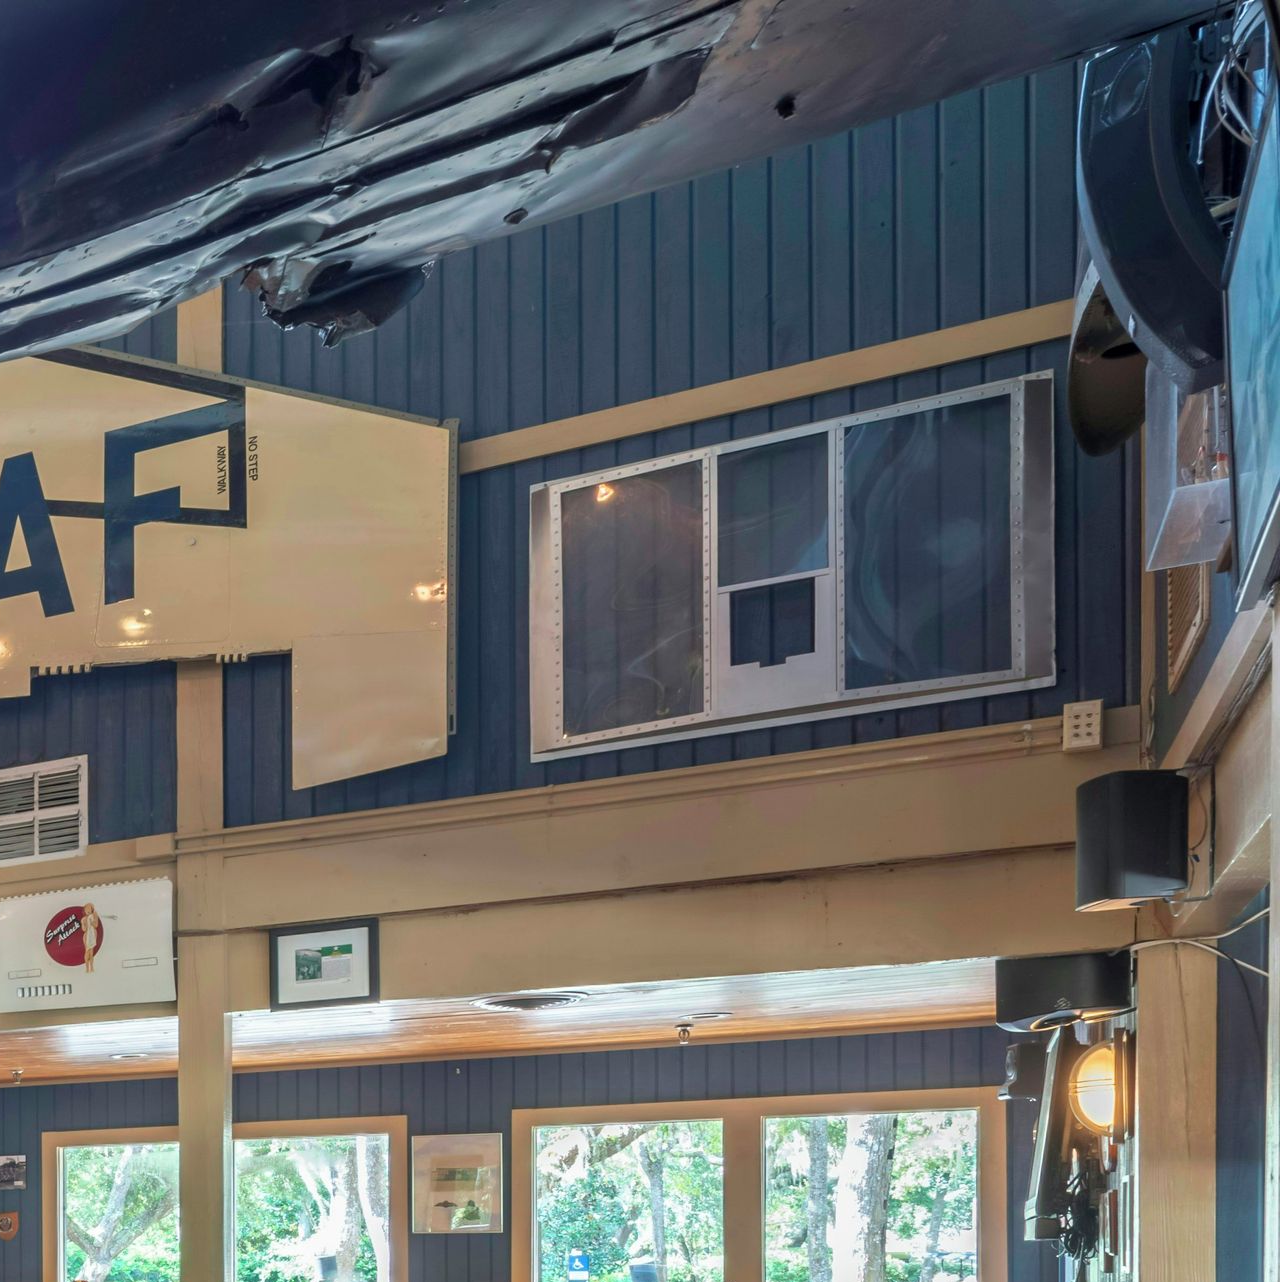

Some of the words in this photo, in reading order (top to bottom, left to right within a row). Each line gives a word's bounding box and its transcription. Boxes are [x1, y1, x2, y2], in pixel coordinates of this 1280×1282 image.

[248, 435, 259, 452] NO
[217, 445, 227, 495] WALKWAY
[248, 454, 259, 481] STEP
[57, 921, 81, 946] Attack
